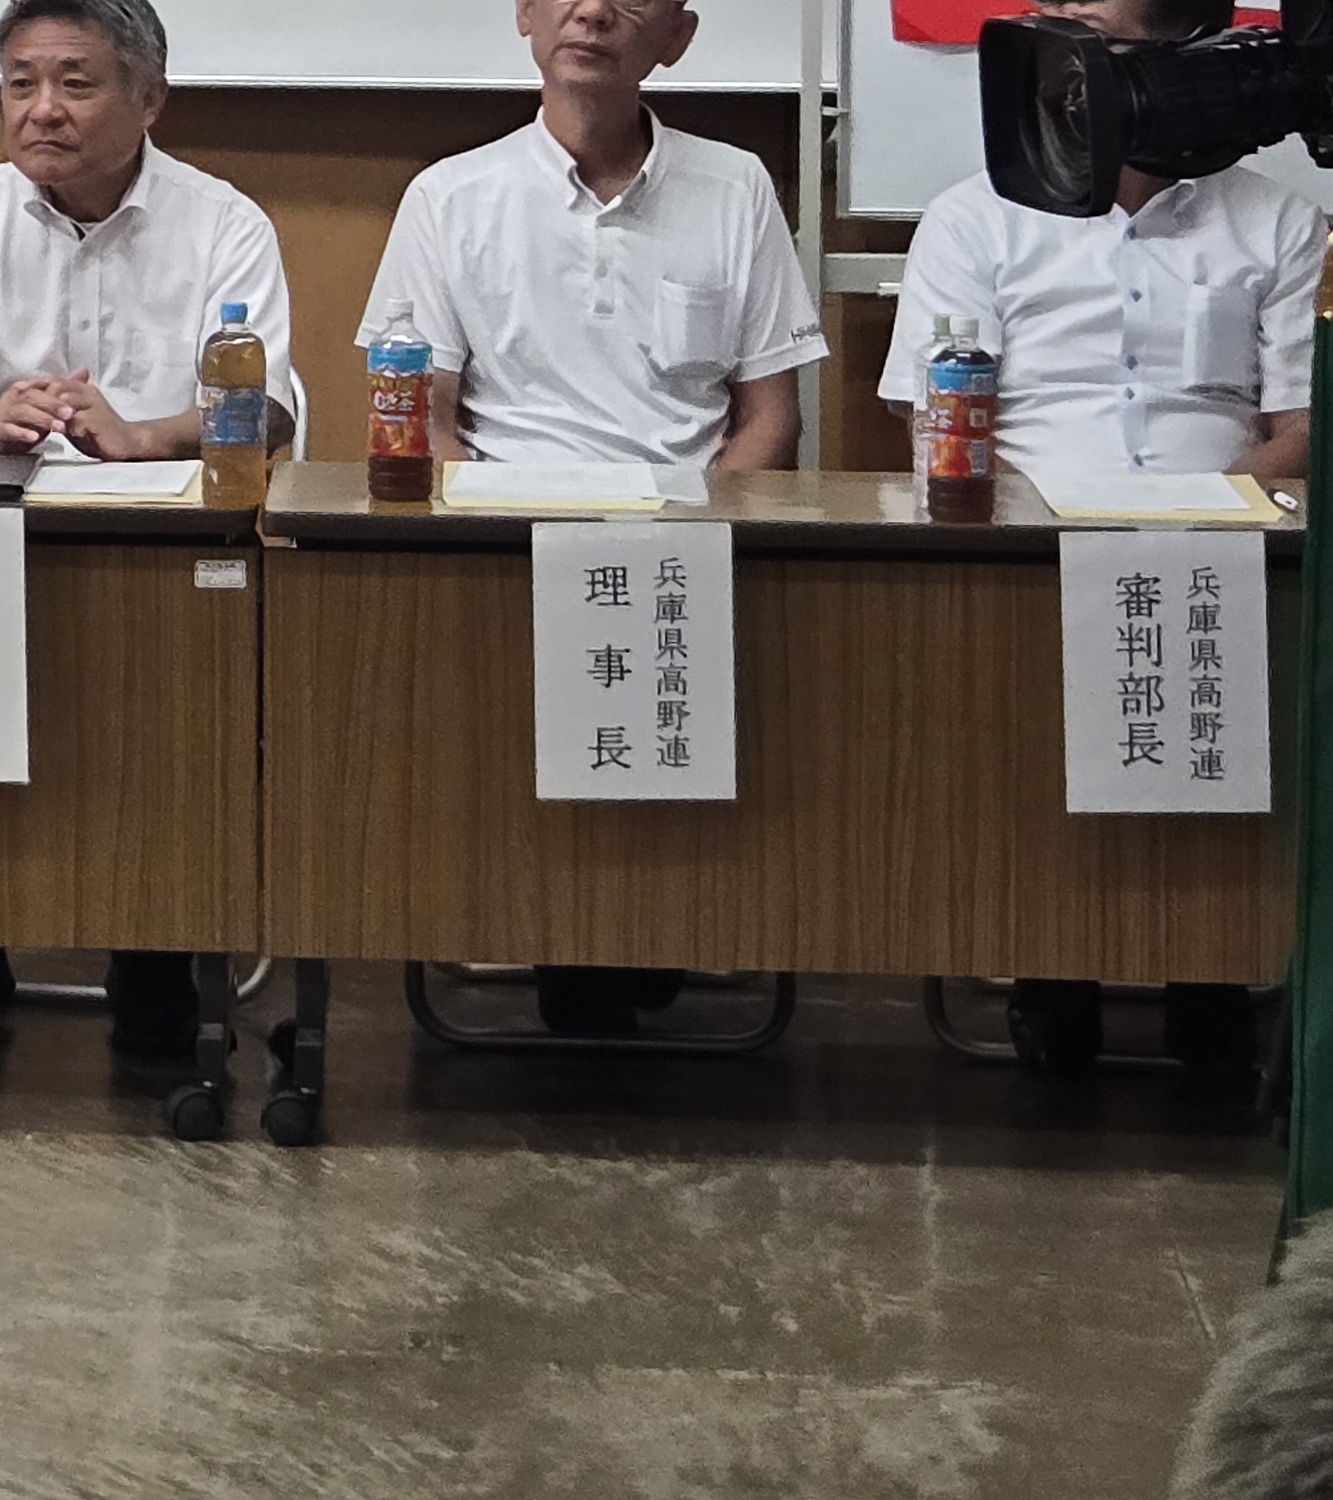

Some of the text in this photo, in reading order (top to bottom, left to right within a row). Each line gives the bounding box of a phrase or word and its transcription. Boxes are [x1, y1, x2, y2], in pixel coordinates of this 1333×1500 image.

[583, 565, 634, 771] 理事長
[653, 557, 691, 768] 兵庫県高野連
[1114, 572, 1165, 768] 審判部長
[1187, 566, 1224, 781] 兵庫県高野連
